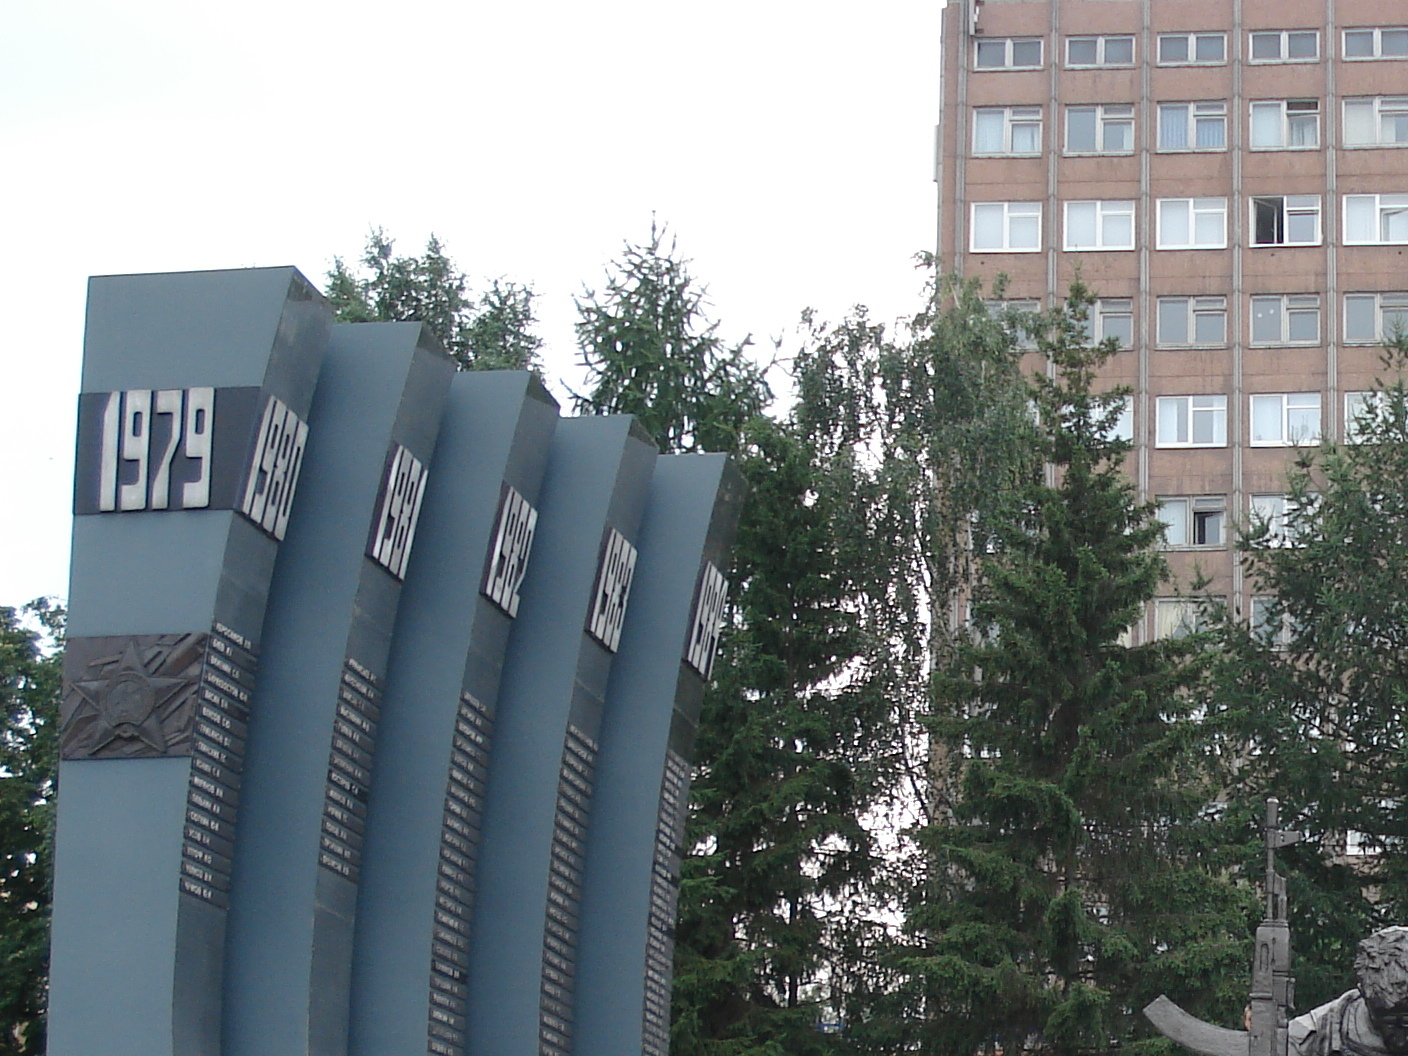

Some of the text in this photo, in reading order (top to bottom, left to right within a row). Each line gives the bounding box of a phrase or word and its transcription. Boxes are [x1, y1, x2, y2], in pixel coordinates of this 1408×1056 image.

[100, 387, 215, 511] 1979
[243, 395, 309, 541] 1980
[372, 445, 428, 581] 1981
[486, 486, 538, 618] 1982
[590, 528, 638, 653] 1983
[687, 561, 729, 681] 1984
